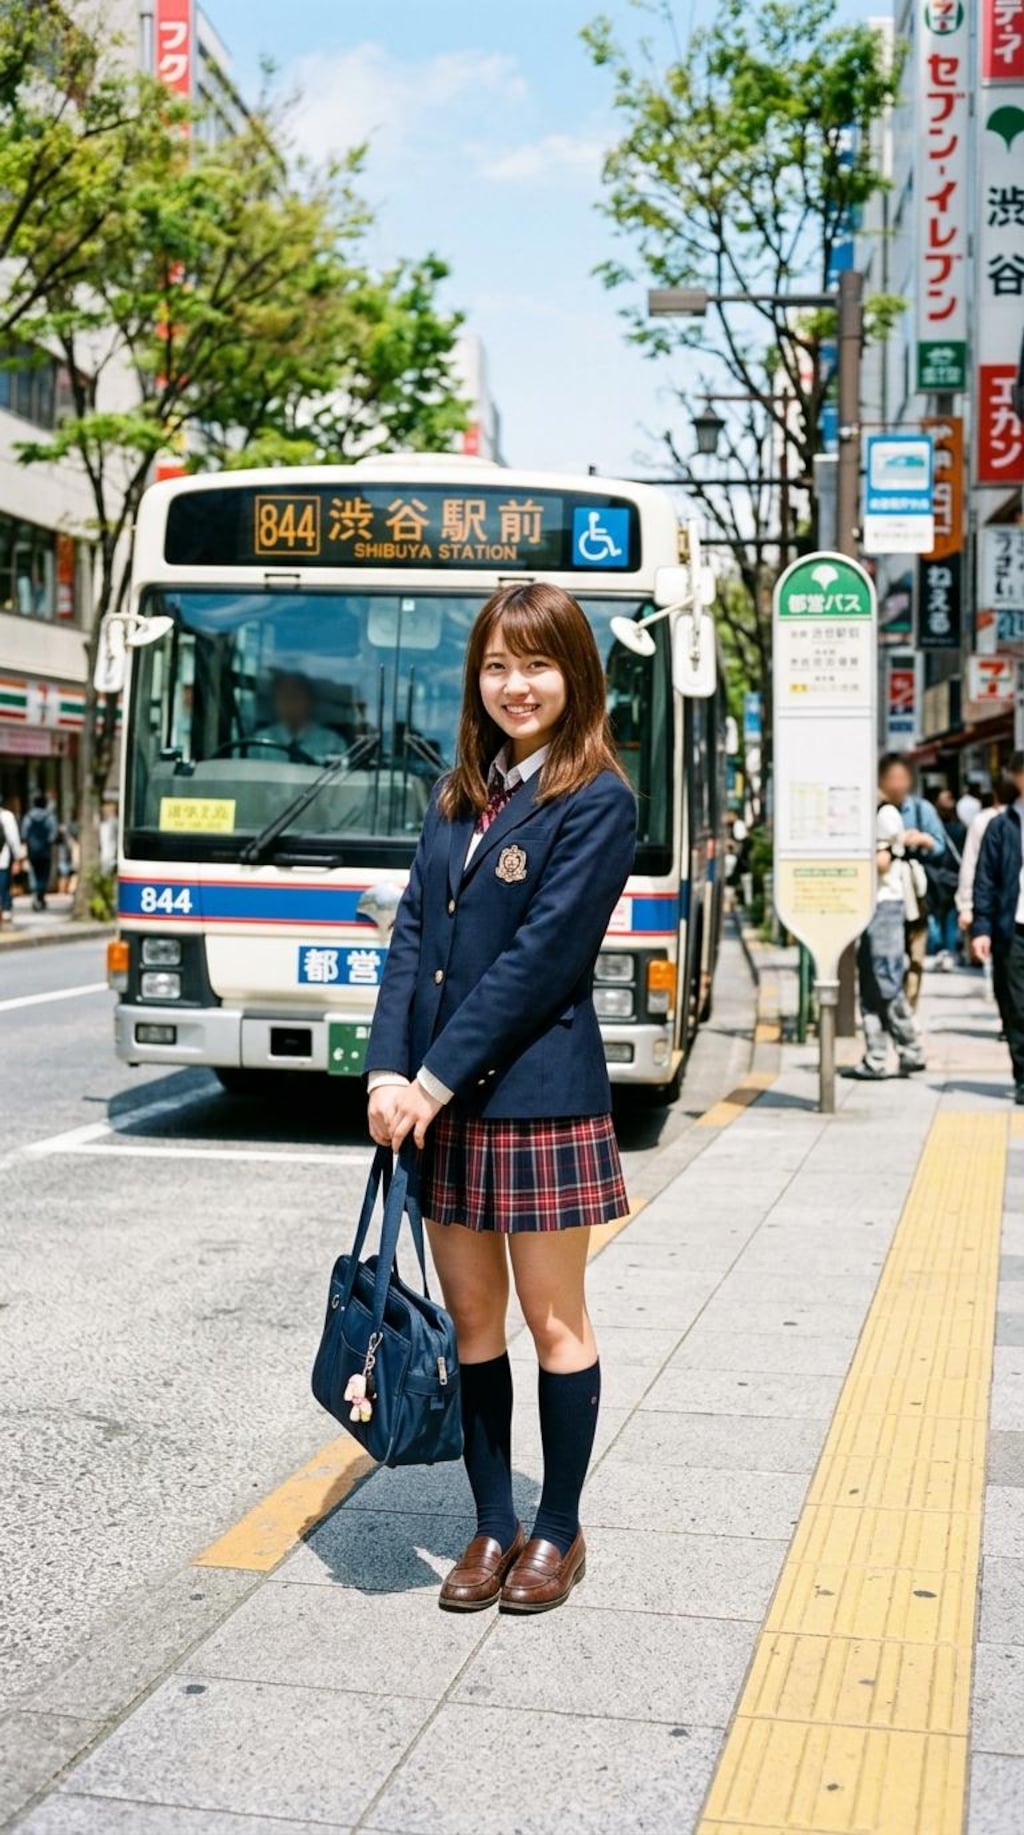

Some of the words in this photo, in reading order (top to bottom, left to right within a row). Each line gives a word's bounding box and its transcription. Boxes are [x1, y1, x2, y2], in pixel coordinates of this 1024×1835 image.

[159, 22, 188, 82] フク
[988, 185, 1024, 296] 渋谷
[259, 503, 315, 547] 844
[328, 497, 545, 544] 渋谷駅前
[354, 542, 432, 559] SHIBUYA
[438, 543, 517, 560] STATION
[788, 593, 862, 614] 都営バス
[140, 887, 193, 914] 844
[303, 948, 380, 983] 都営
